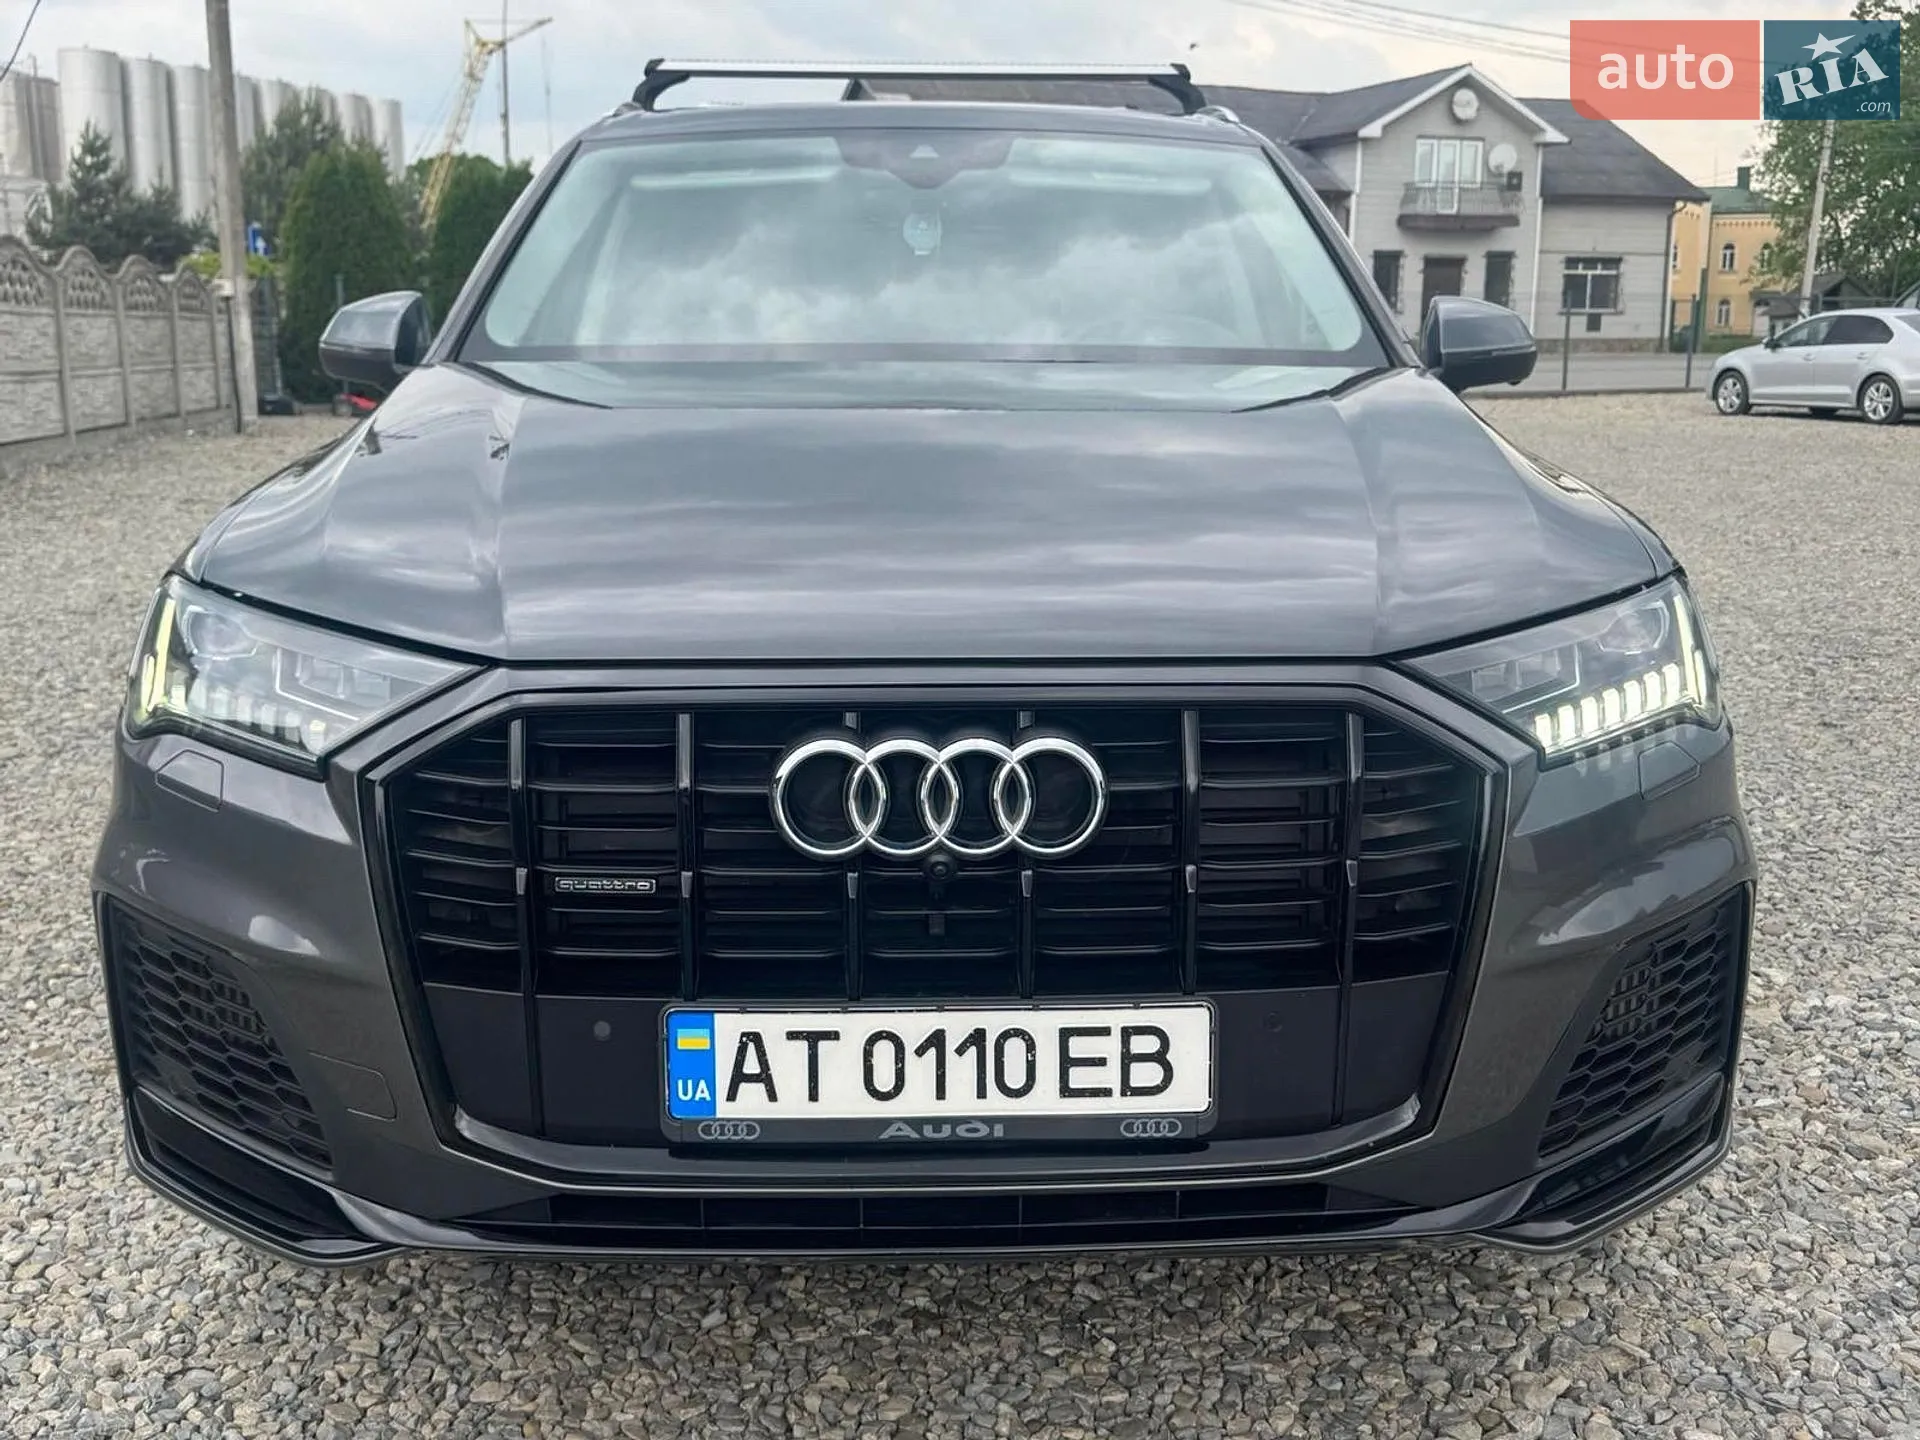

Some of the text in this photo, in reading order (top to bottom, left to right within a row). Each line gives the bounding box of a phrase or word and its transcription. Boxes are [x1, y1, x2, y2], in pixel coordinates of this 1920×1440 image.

[558, 879, 653, 892] quattro
[725, 1025, 1175, 1102] AT 0110 EB
[677, 1079, 712, 1101] UA
